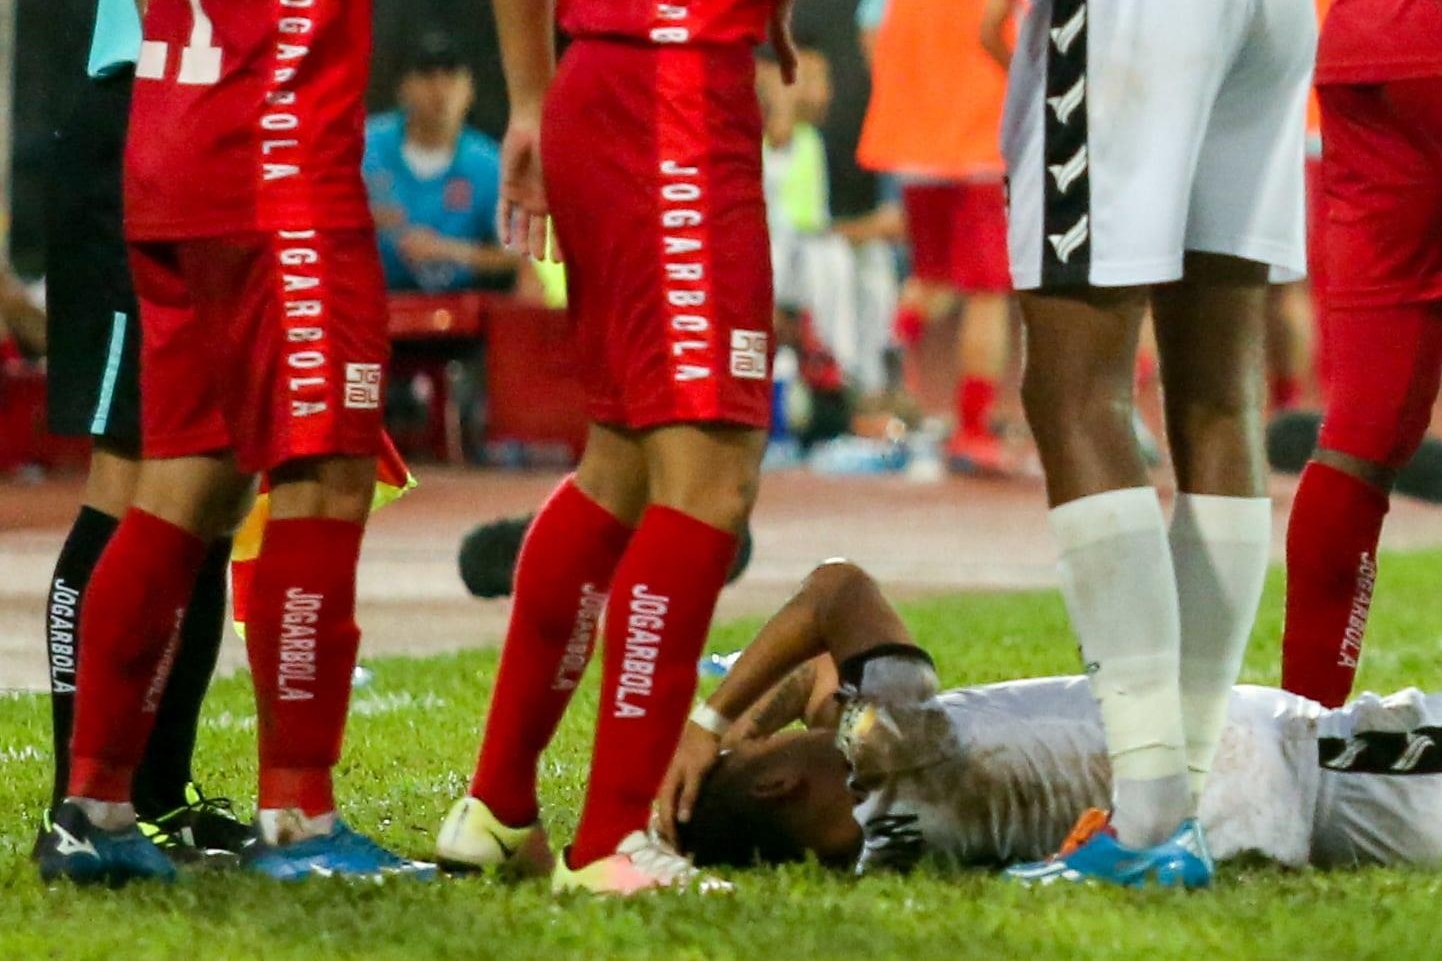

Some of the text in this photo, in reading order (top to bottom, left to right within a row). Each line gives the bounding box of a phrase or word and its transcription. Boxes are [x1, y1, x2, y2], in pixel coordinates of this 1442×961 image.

[659, 159, 711, 382] JOGARBOLA
[51, 576, 79, 694] JOGARBOLA
[276, 586, 324, 701] JOGARBOLA
[612, 583, 671, 718] JOGARBOLA
